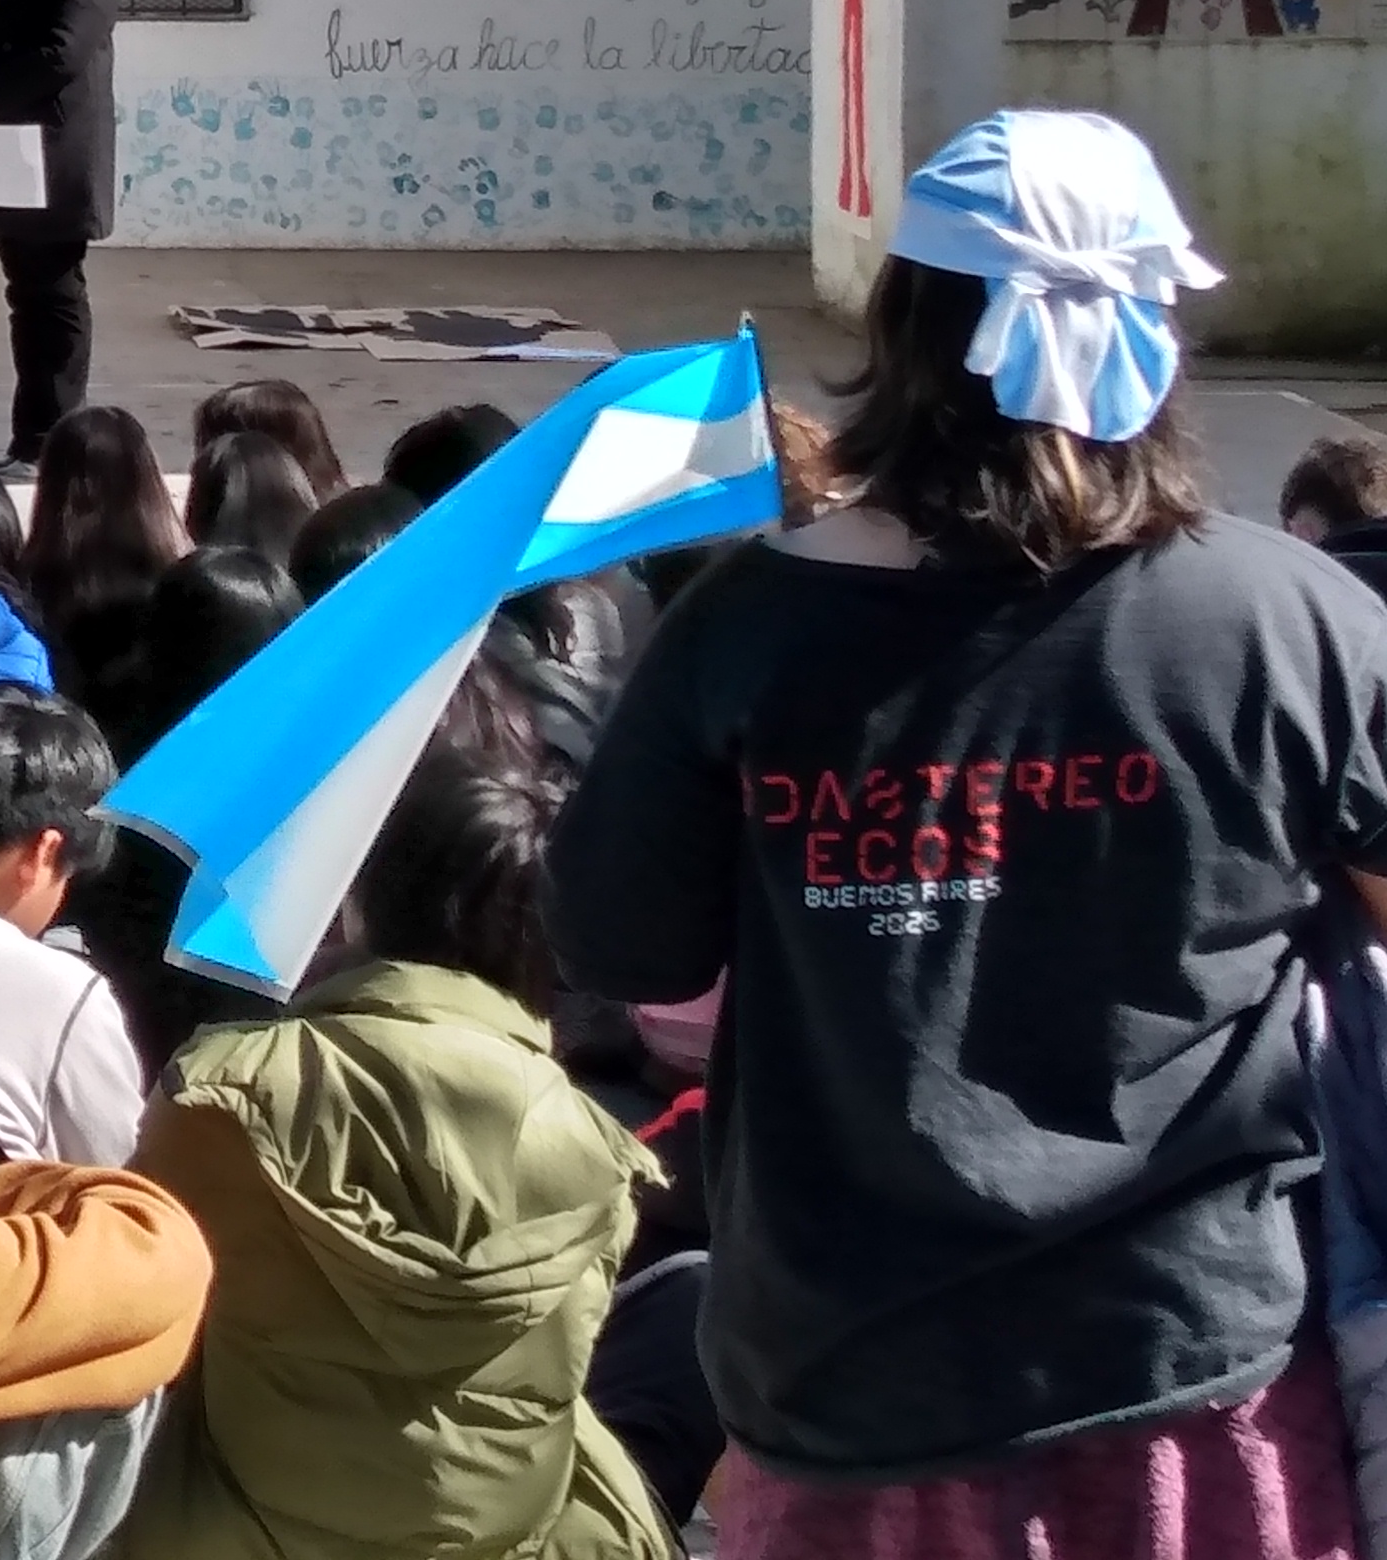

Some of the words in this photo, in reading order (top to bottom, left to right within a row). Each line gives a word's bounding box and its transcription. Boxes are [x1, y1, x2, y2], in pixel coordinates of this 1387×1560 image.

[583, 16, 626, 70] la
[805, 826, 1003, 883] ECOS
[804, 884, 915, 909] BUENOS
[920, 874, 1003, 905] AIRES
